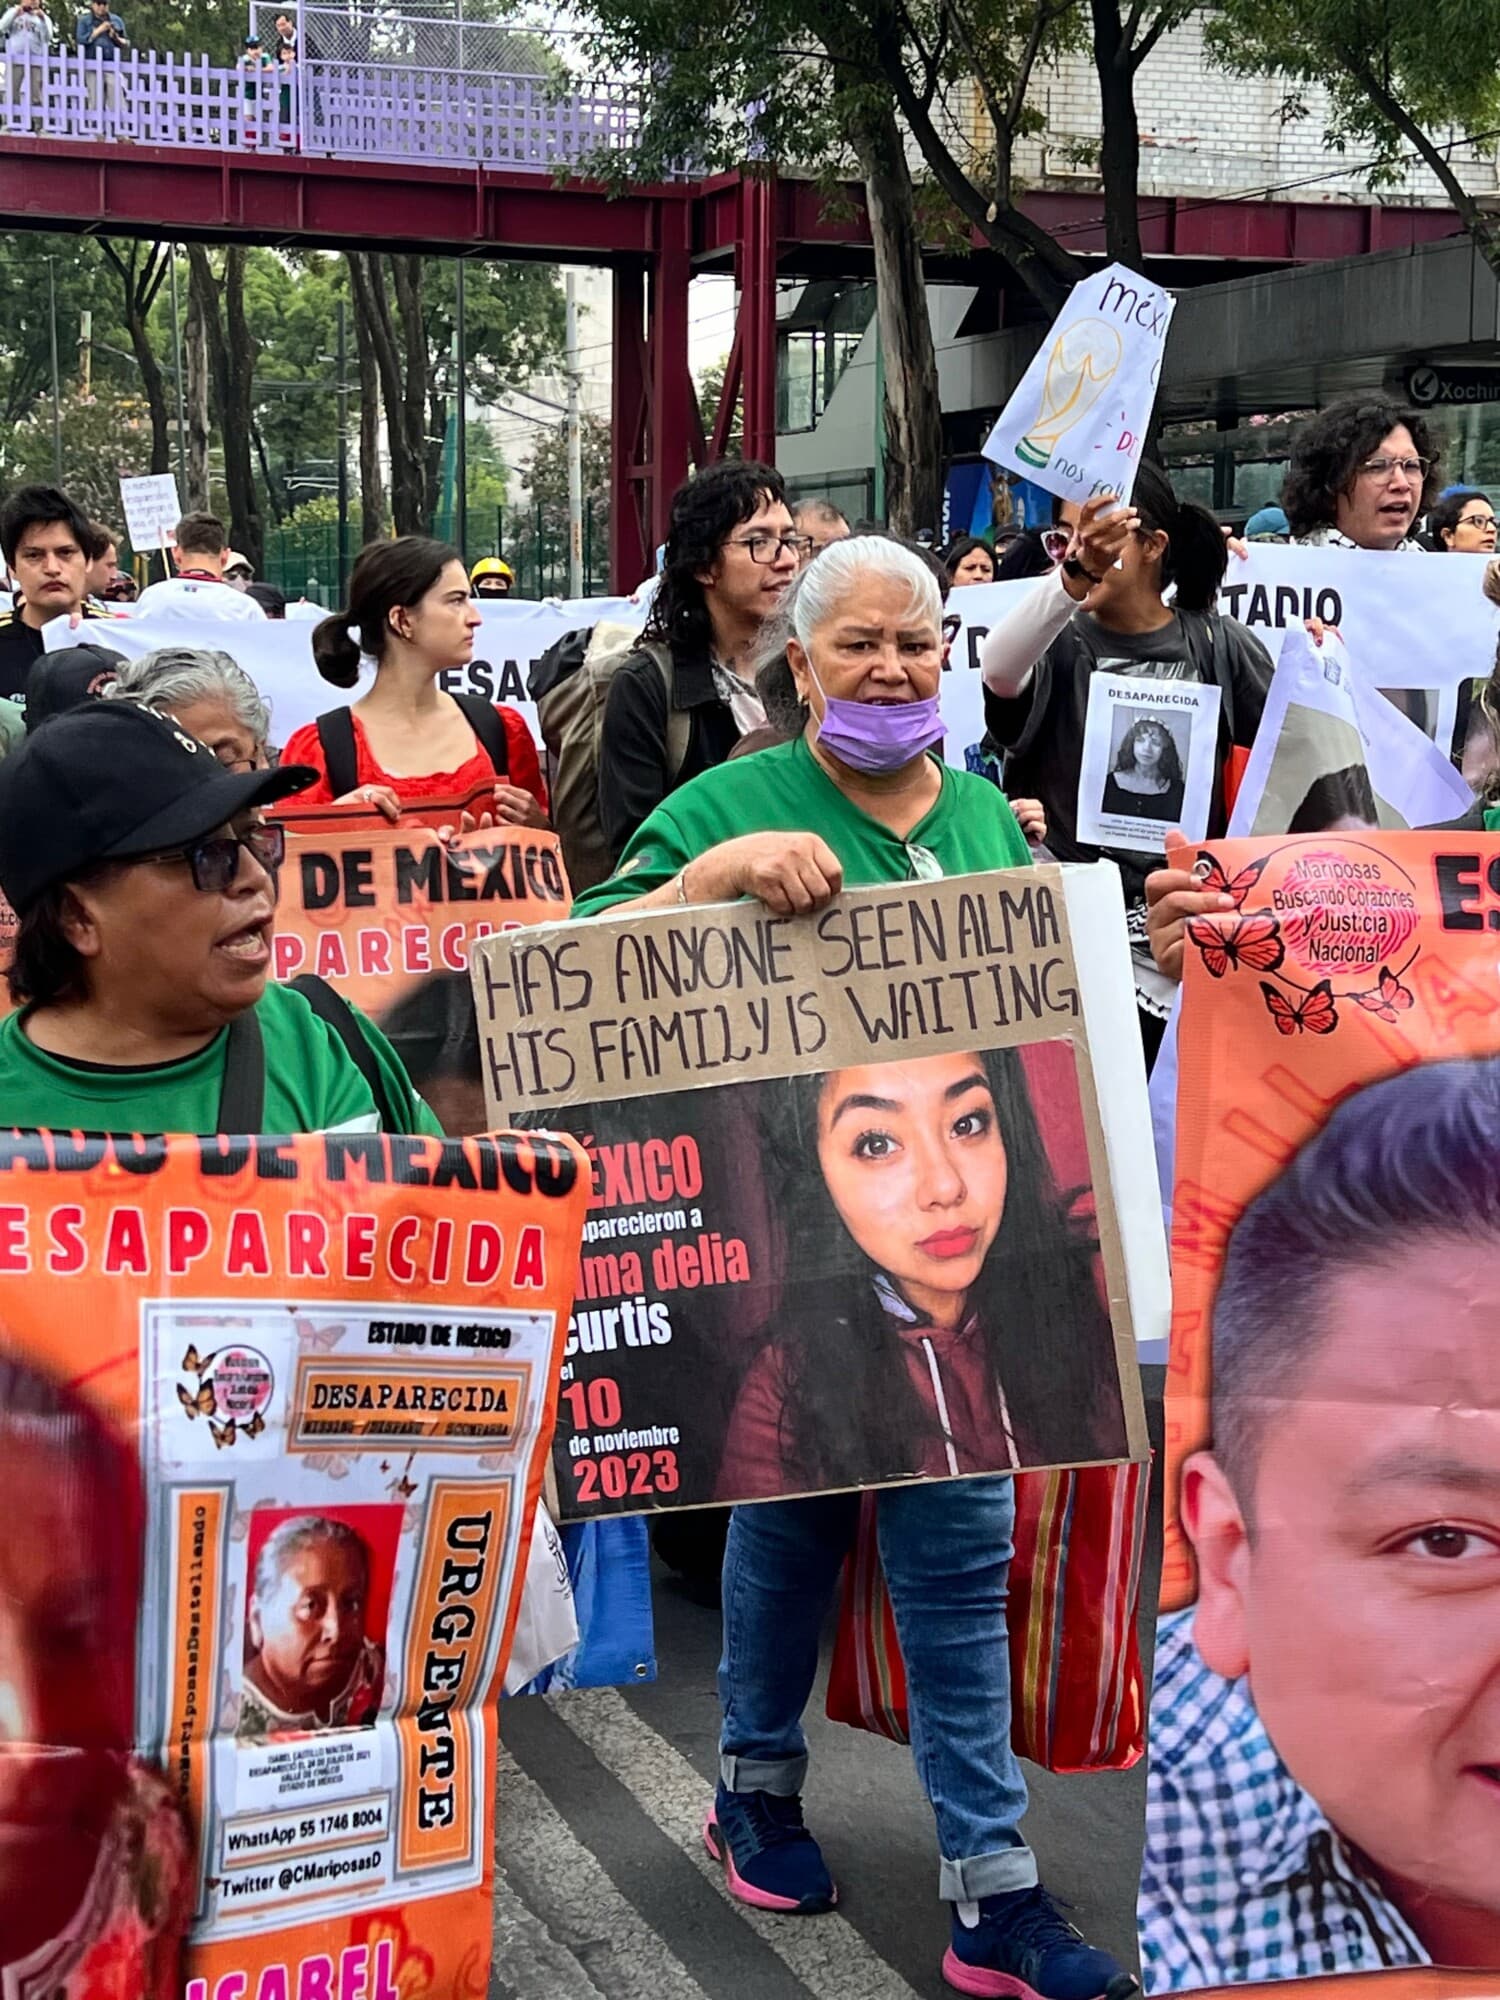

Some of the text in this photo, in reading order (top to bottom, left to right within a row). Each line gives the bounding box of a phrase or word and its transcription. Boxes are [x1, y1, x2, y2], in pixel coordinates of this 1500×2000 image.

[1054, 457, 1085, 483] nos
[440, 659, 534, 702] ESA
[1108, 688, 1200, 707] DESAPARECIDA
[301, 844, 565, 909] DE MEXICO
[1295, 860, 1381, 883] Mariposas
[1273, 885, 1414, 910] Buscando Corazones
[1302, 911, 1387, 936] y Justicia
[275, 920, 521, 980] PAREC
[483, 886, 1061, 1020] HAS ANYONE SEEN ALMA
[1309, 938, 1380, 963] Nacional
[487, 958, 1079, 1101] HIS FAMILY IS WAITING
[200, 1134, 298, 1179] DE
[690, 1207, 703, 1228] a
[652, 1233, 750, 1291] delia
[368, 1321, 426, 1345] ESTADO
[431, 1324, 451, 1346] DE
[563, 1296, 672, 1356] curtis
[560, 1362, 574, 1380] el
[311, 1383, 509, 1413] DESAPARECIDA
[562, 1378, 622, 1430] 10
[569, 1425, 680, 1456] de noviembre
[573, 1450, 680, 1502] 2023
[416, 1510, 492, 1828] URGENTE
[228, 1827, 296, 1850] WhatsApp
[300, 1819, 315, 1838] 55
[222, 1851, 382, 1898] Twitter @CMariposasD
